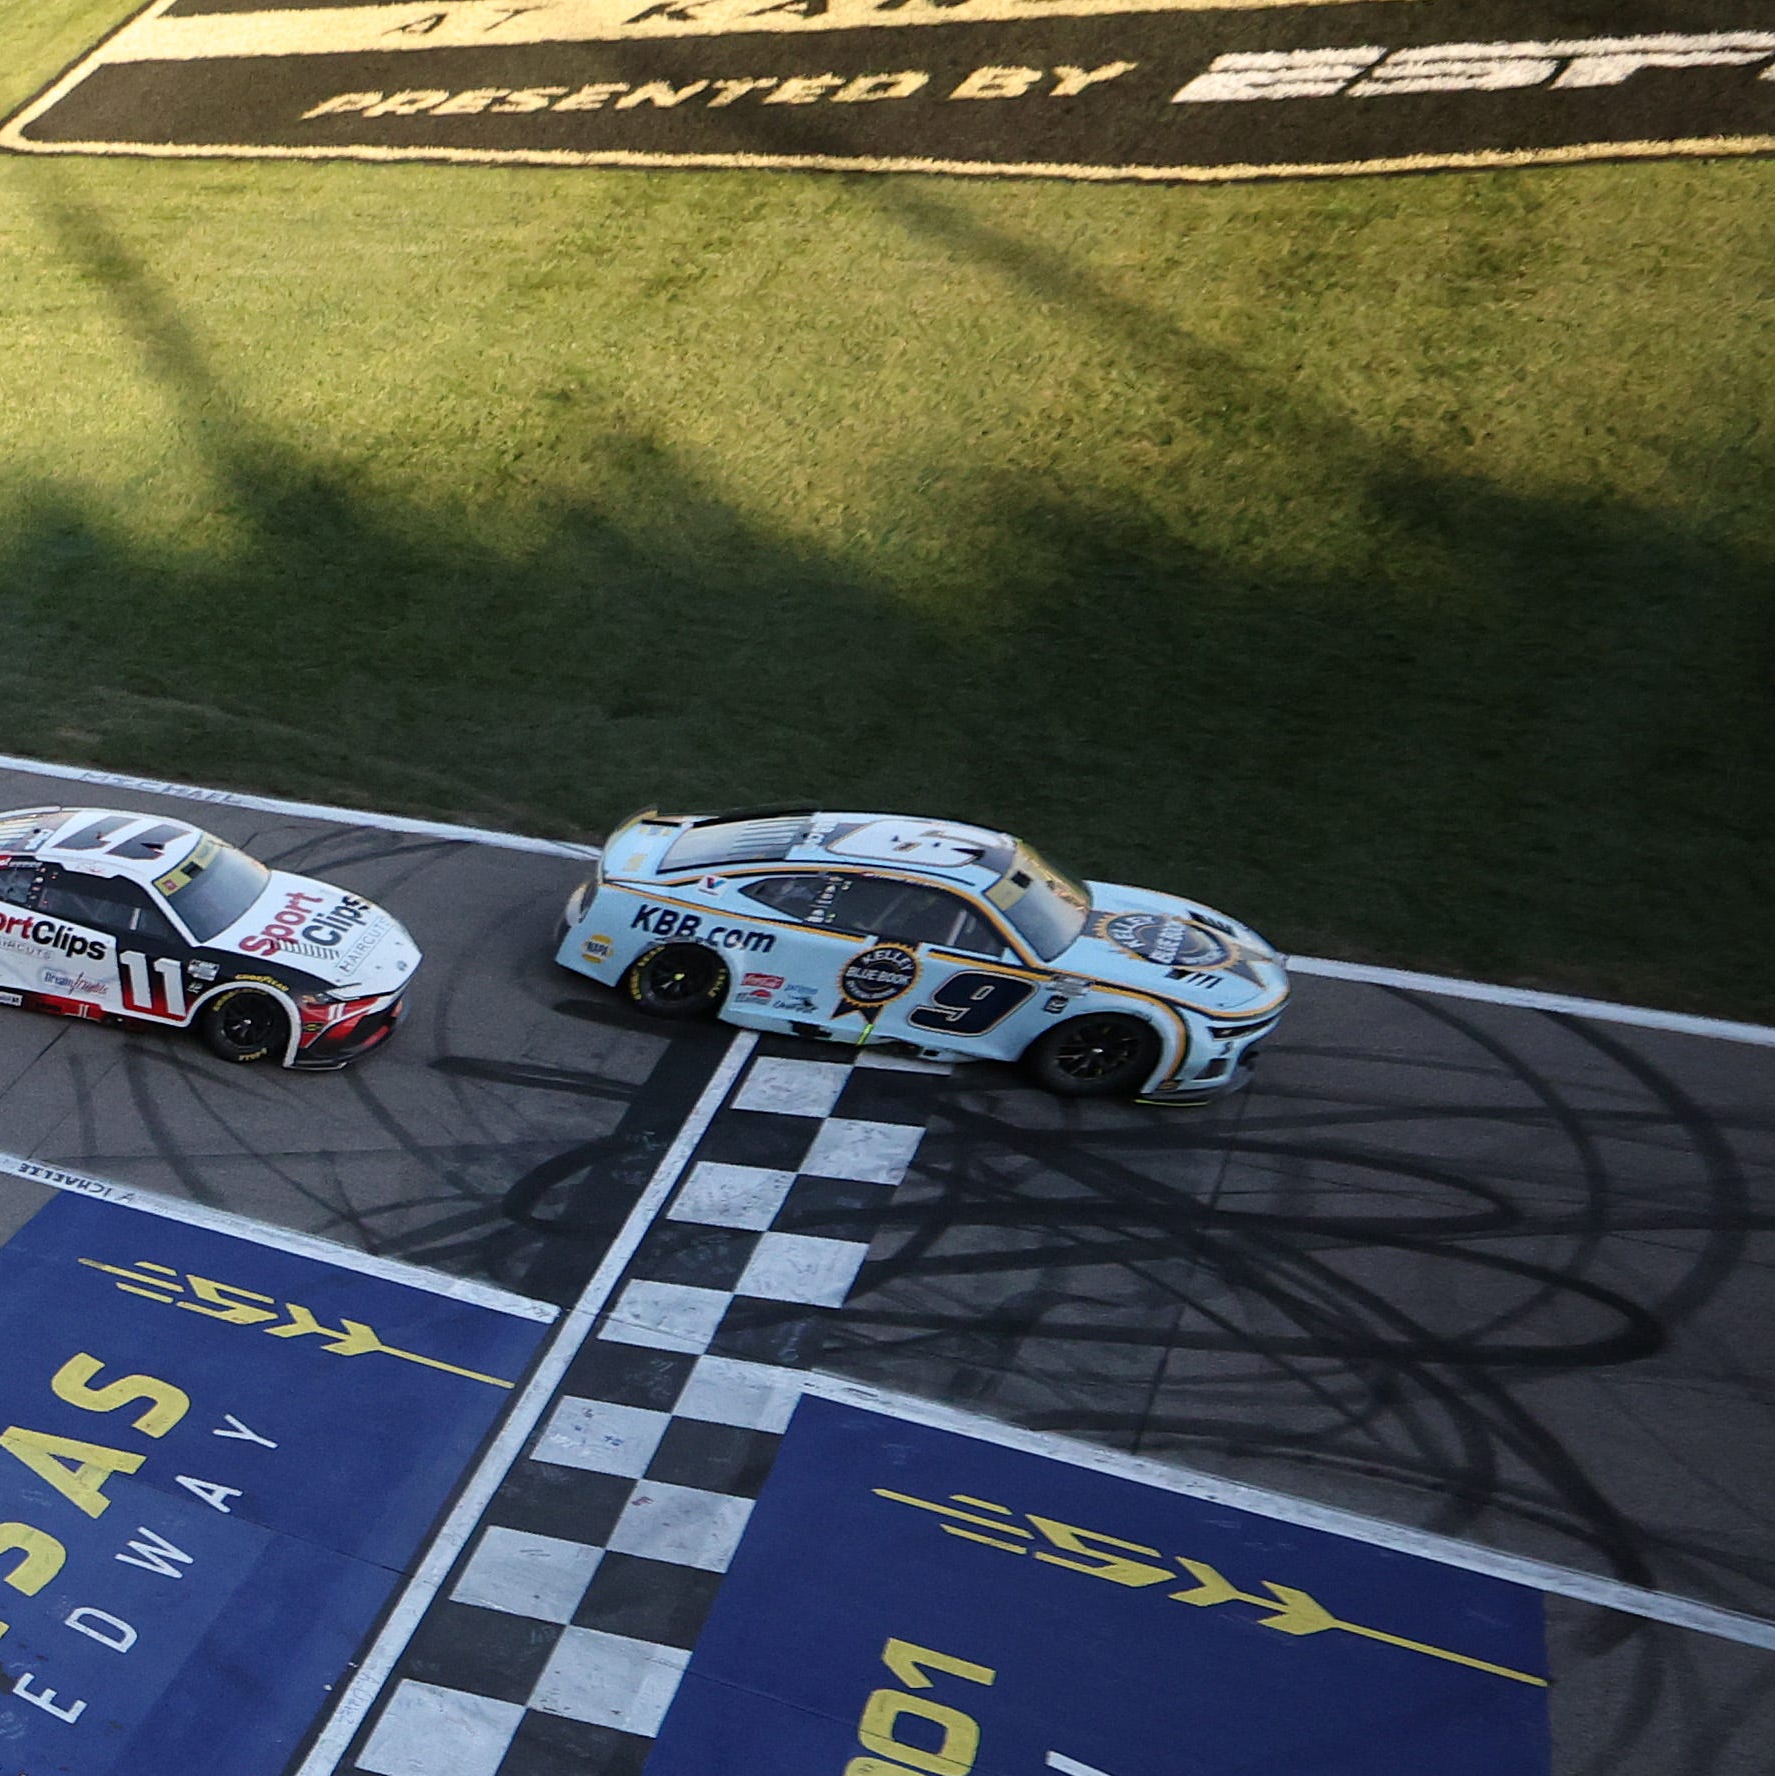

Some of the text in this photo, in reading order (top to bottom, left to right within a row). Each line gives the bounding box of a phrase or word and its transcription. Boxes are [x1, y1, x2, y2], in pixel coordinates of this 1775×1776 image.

[301, 31, 1775, 120] PRESENTED BY ESP
[238, 892, 324, 956] Sport
[301, 894, 372, 947] Clips
[630, 902, 777, 953] KBB.com
[120, 951, 187, 1017] 11
[861, 949, 916, 972] KELLEY
[908, 969, 1040, 1038] 9
